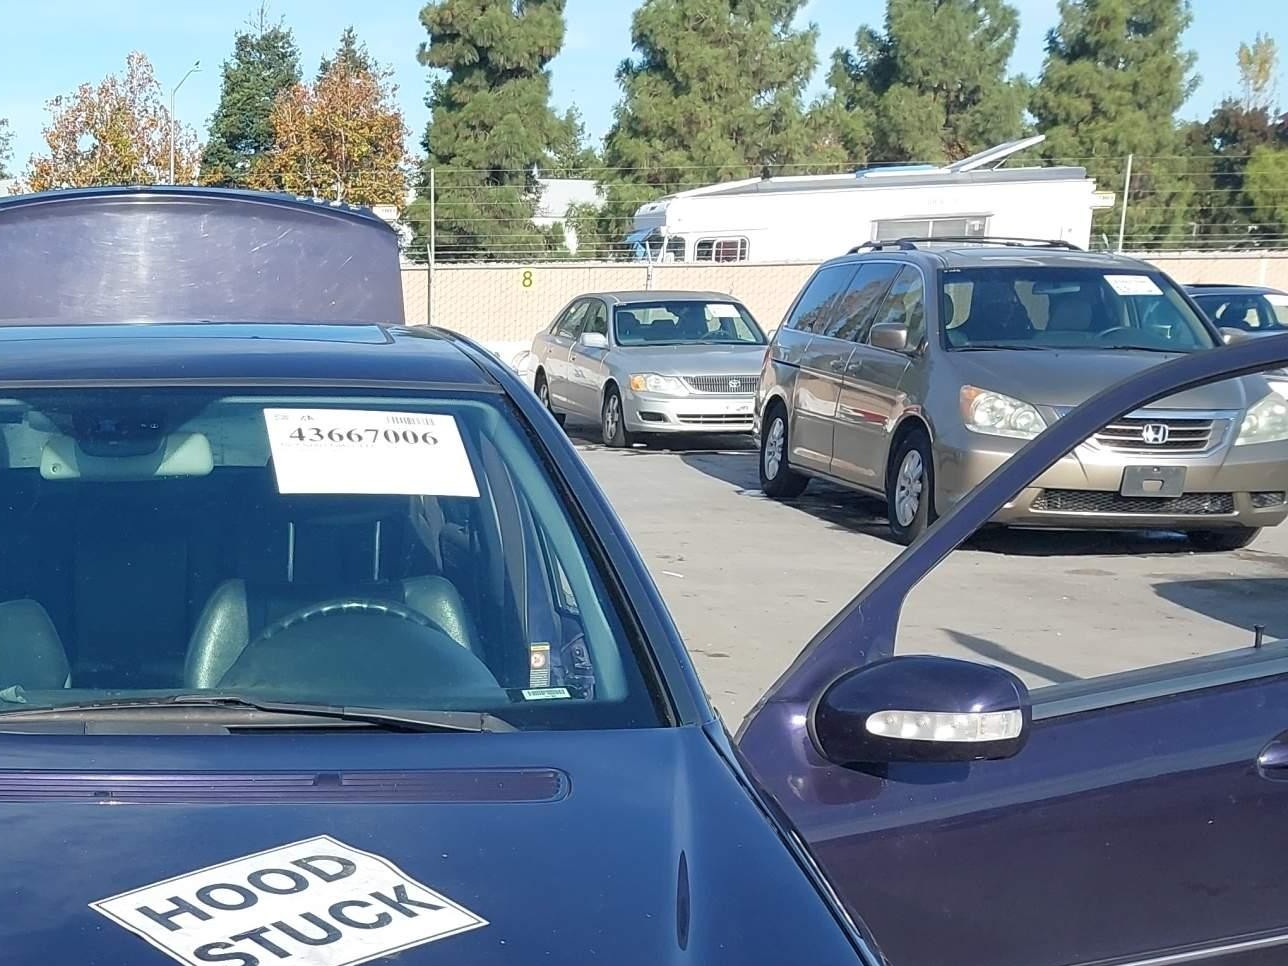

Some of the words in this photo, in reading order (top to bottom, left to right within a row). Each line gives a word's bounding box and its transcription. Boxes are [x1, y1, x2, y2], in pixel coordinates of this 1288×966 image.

[522, 270, 533, 287] 8
[289, 427, 439, 446] 43667006
[135, 854, 358, 932] HOOD
